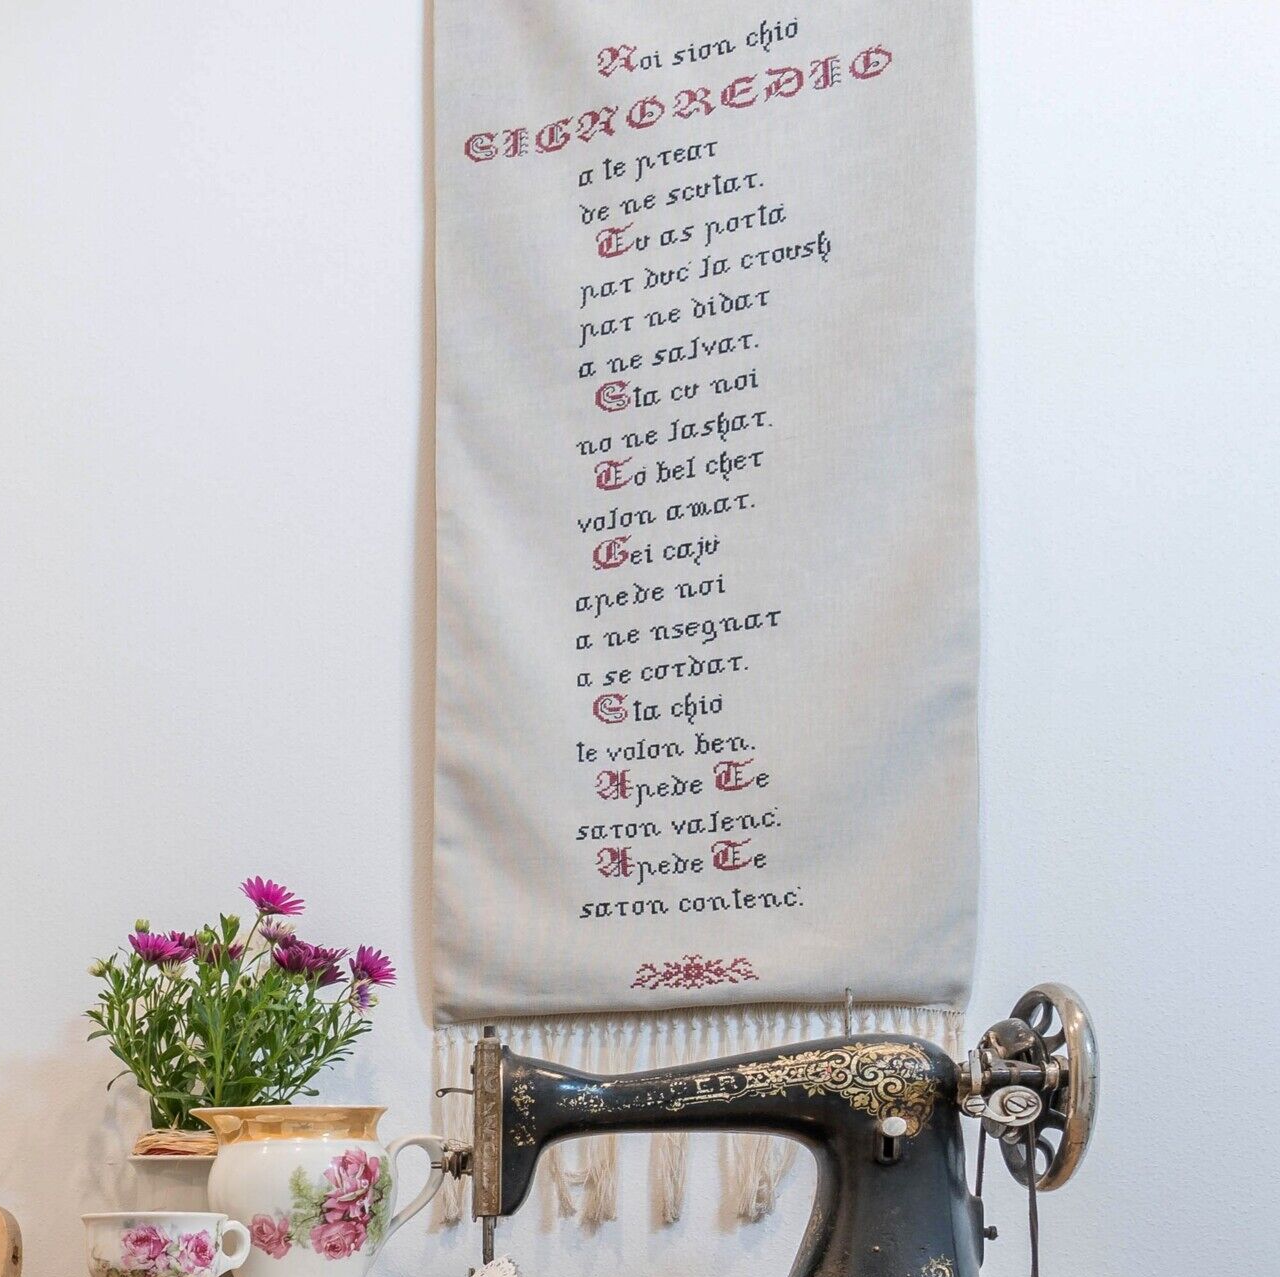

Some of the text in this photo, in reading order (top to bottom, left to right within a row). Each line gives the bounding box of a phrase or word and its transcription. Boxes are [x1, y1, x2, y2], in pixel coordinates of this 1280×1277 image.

[671, 39, 737, 66] sion
[464, 45, 893, 162] SIGNOREDIO
[578, 168, 594, 188] a
[602, 157, 626, 181] te
[578, 204, 610, 226] de
[619, 193, 656, 216] ne
[595, 221, 651, 259] Tu
[660, 225, 695, 247] as
[698, 254, 731, 279] la
[643, 307, 681, 328] ne
[577, 361, 597, 379] a
[606, 354, 643, 374] ne
[594, 368, 759, 413] Sta cu noi
[575, 436, 612, 456] no
[620, 429, 658, 449] ne
[655, 455, 696, 484] bel
[577, 507, 657, 534] volon
[575, 573, 726, 619] apede noi
[575, 634, 594, 651] a
[602, 628, 640, 648] ne
[576, 672, 593, 688] a
[602, 668, 632, 687] se
[592, 693, 662, 725] Sta
[575, 732, 756, 763] te volon ben.
[594, 757, 770, 808] Apede Te
[595, 837, 767, 886] Apede Te
